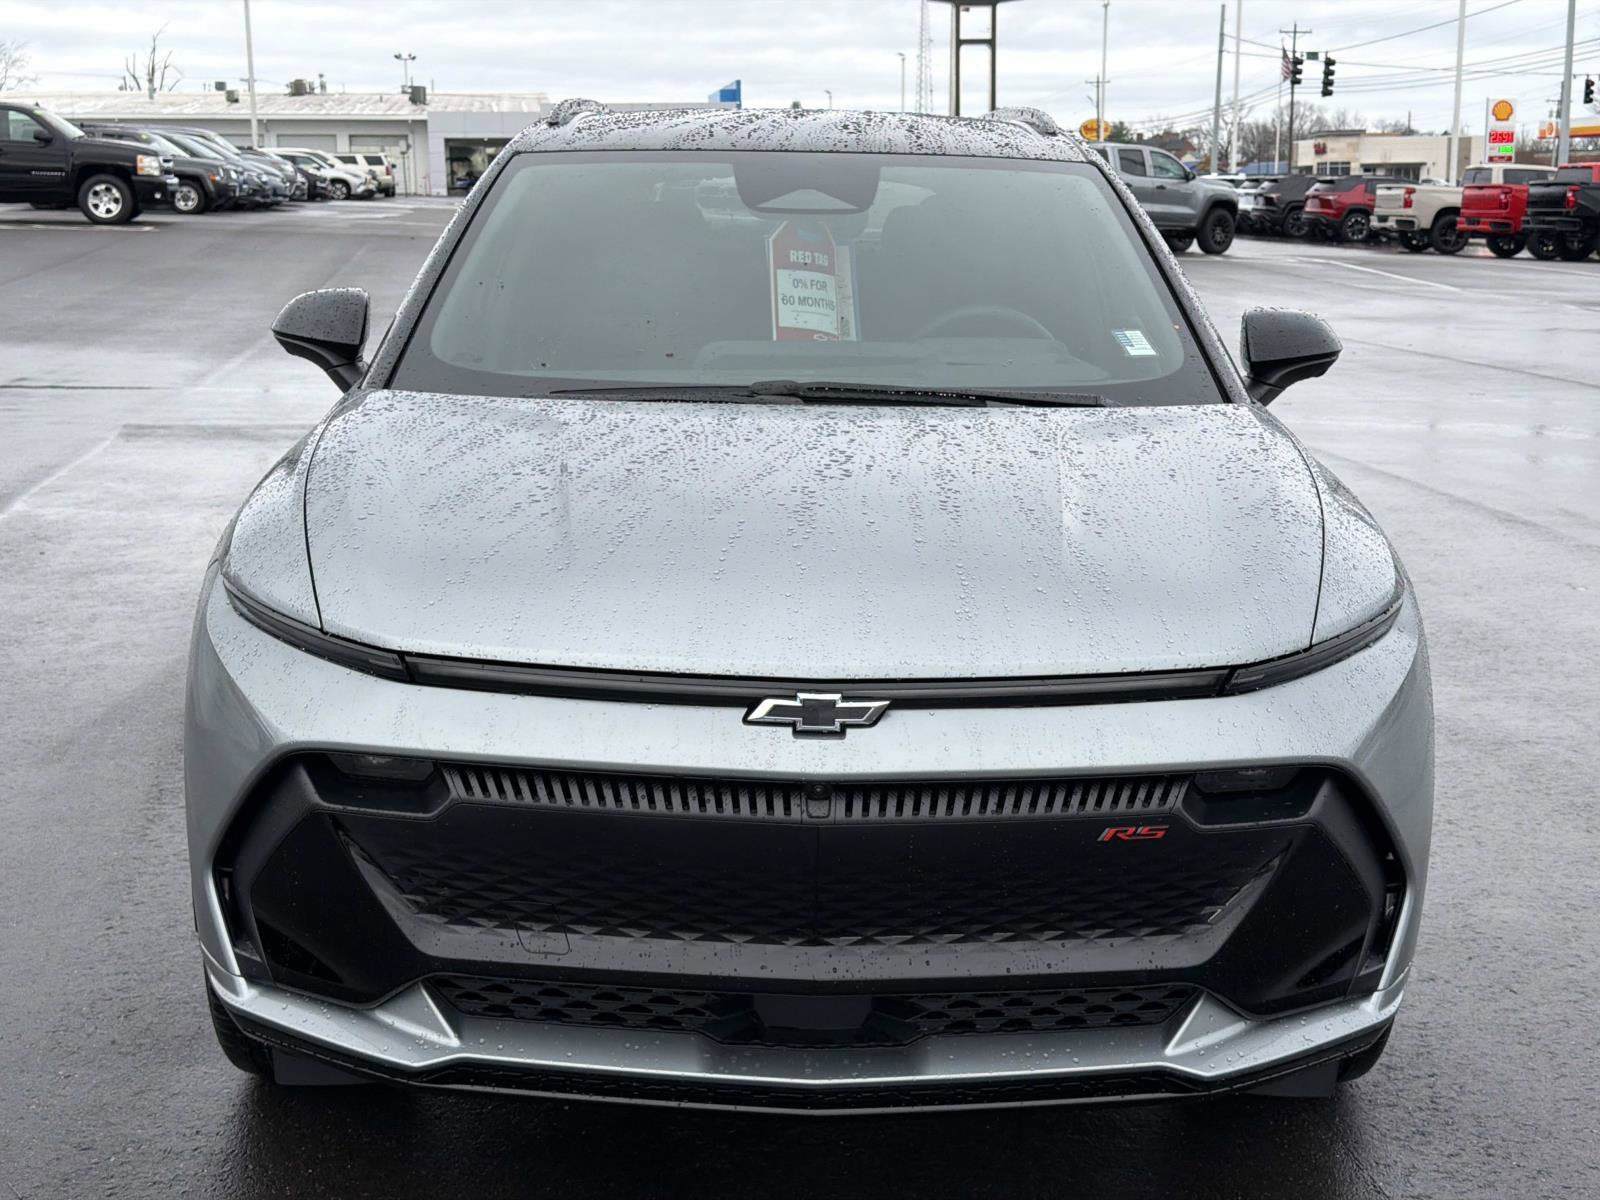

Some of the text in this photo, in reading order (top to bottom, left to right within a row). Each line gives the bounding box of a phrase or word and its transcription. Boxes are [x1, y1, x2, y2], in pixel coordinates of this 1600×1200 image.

[790, 249, 812, 264] RED
[792, 278, 828, 292] 0% FOR
[781, 295, 836, 311] 60 MONTHS
[1096, 824, 1169, 842] RS
